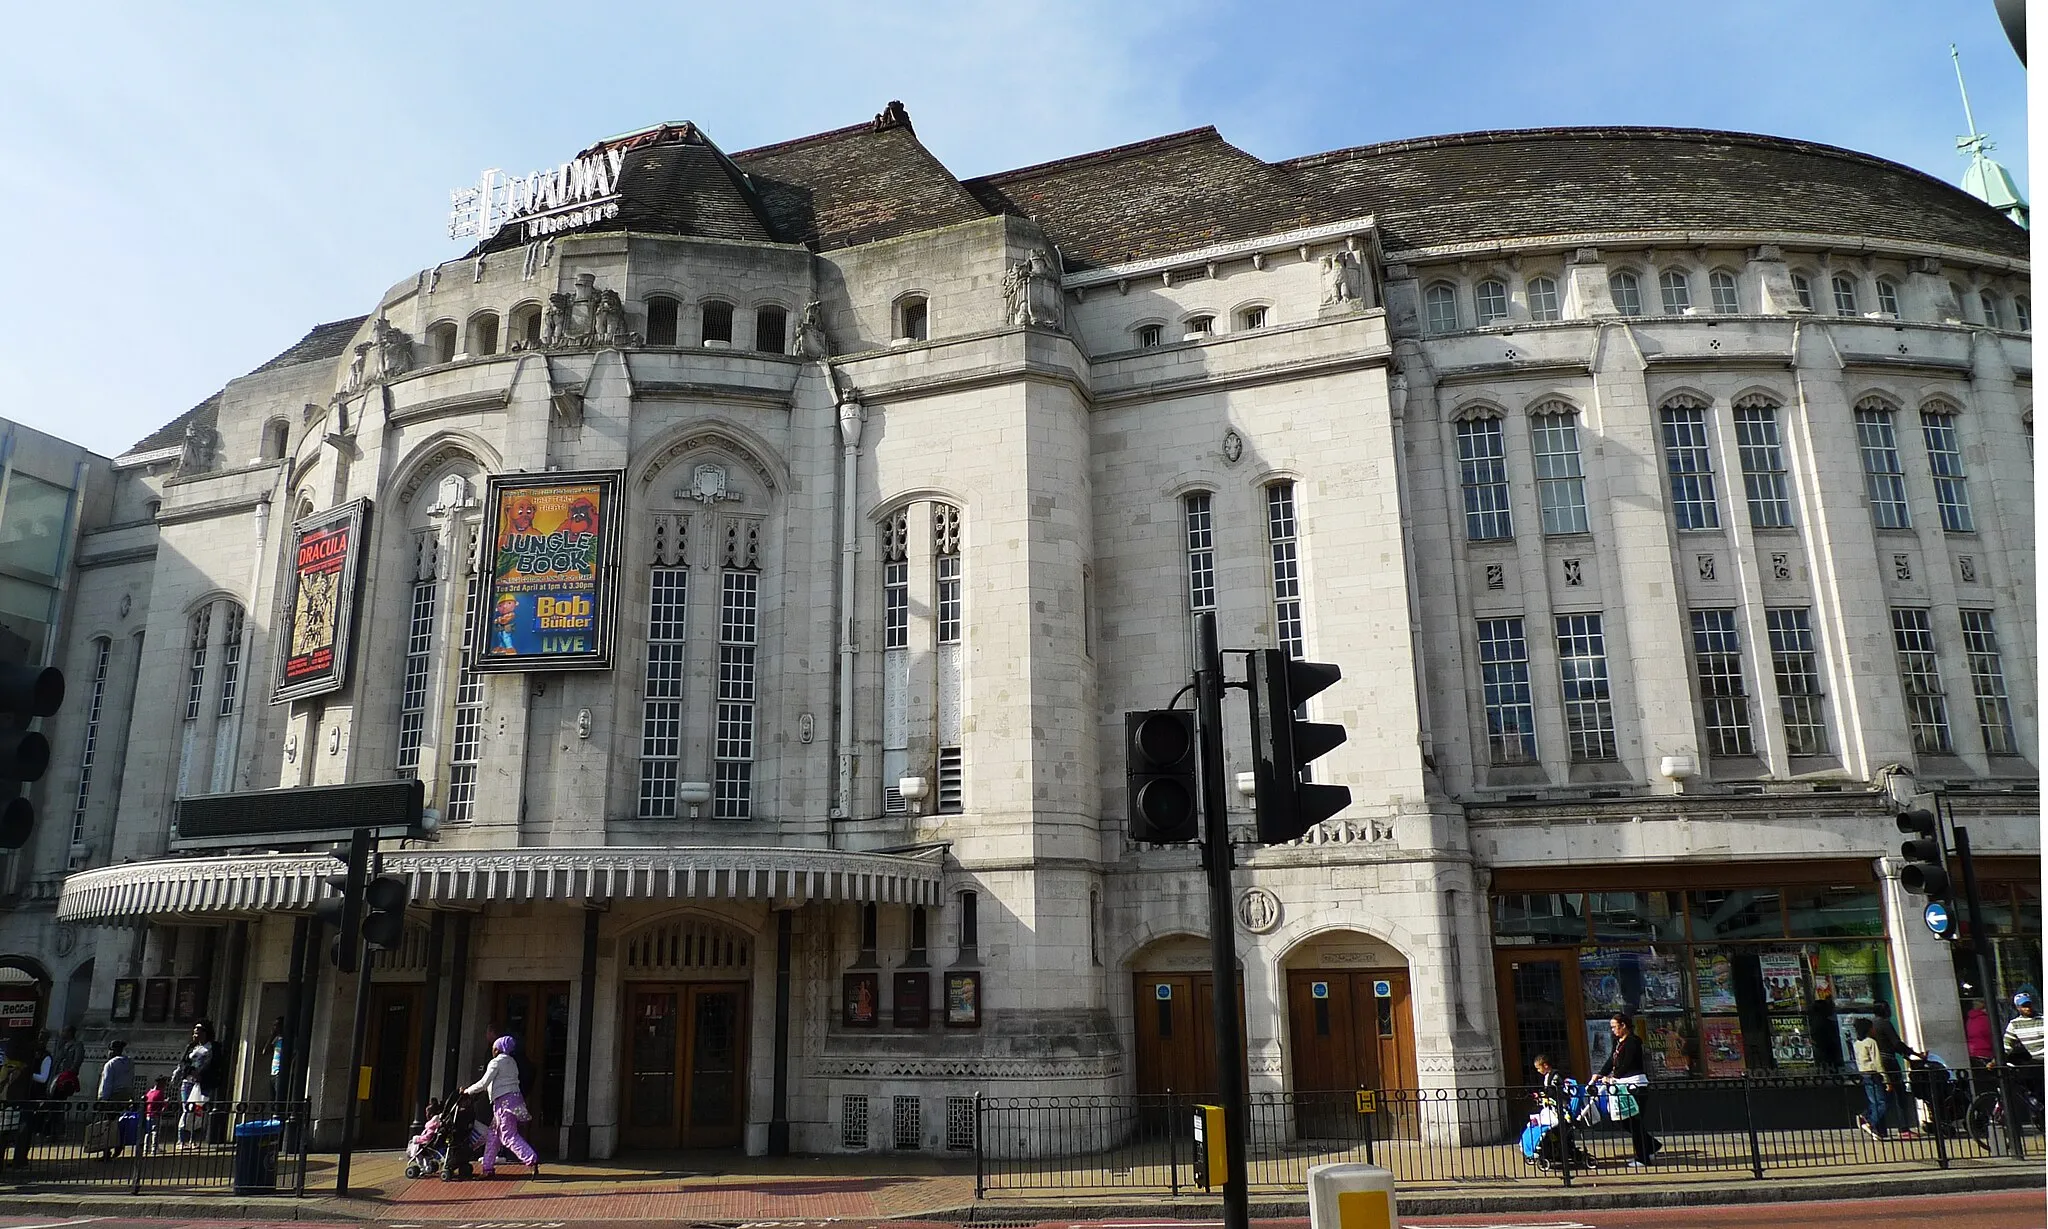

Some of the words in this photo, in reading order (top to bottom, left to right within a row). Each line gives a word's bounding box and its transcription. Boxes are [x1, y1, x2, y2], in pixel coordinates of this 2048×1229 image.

[298, 534, 347, 566] DRACULA
[502, 530, 593, 554] JUNGLE
[515, 549, 590, 575] BOOK
[509, 584, 521, 592] 3rd
[521, 583, 538, 592] April
[539, 583, 546, 591] at
[548, 582, 561, 591] 1pm
[568, 581, 594, 590] 3.30pm
[537, 595, 590, 617] Bob
[540, 616, 592, 629] Builder
[542, 635, 585, 653] LIVE
